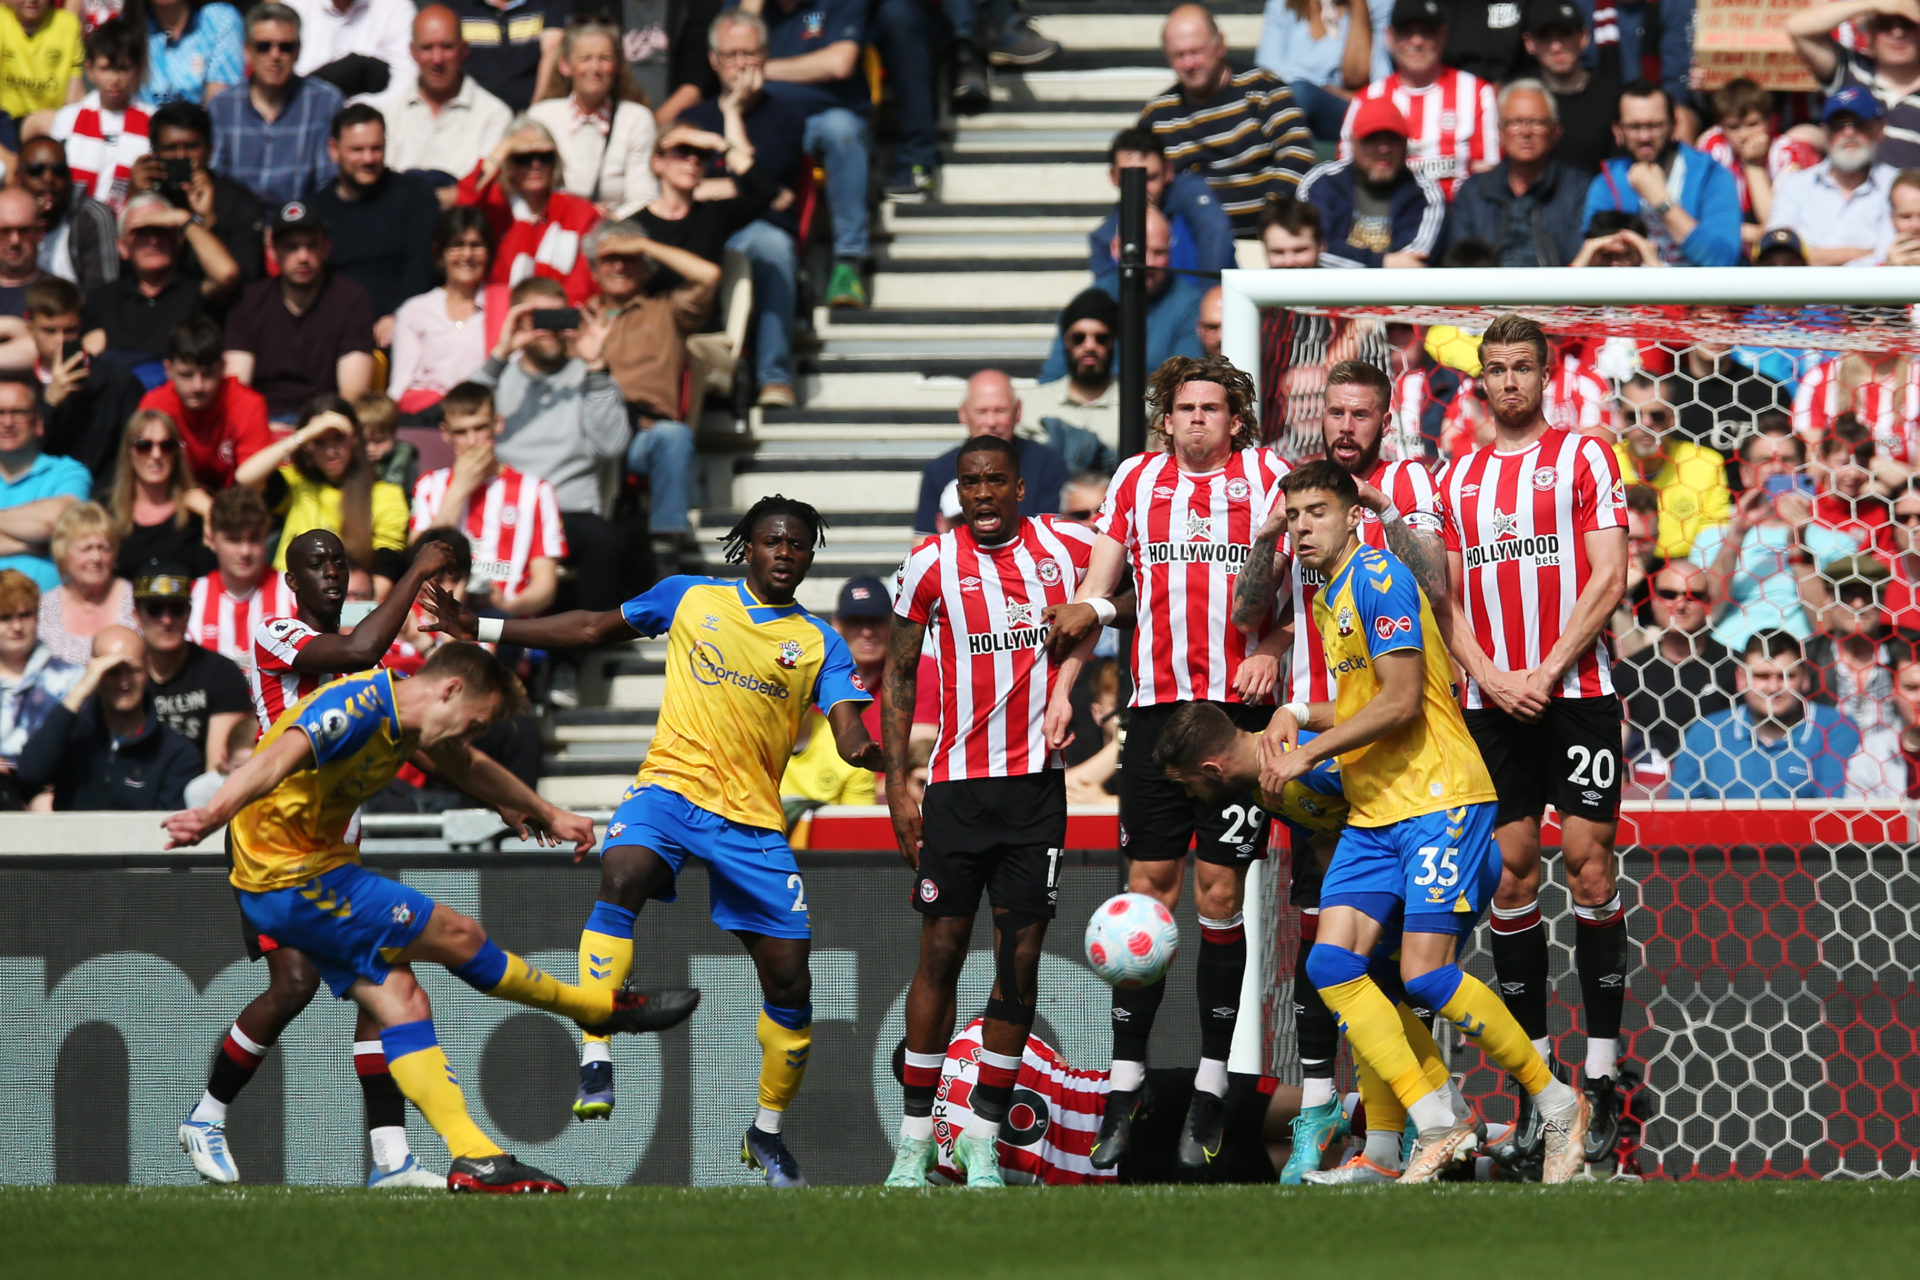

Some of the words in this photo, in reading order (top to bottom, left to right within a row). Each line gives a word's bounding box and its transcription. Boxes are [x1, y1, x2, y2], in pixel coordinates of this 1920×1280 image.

[1149, 541, 1250, 563] HOLLYWOOD
[1225, 563, 1244, 573] bet
[1467, 535, 1559, 568] HOLLYWOOD
[1535, 554, 1559, 567] bets
[968, 626, 1050, 654] HOLLYWO
[1567, 744, 1615, 789] 20
[1218, 804, 1266, 844] 29
[1047, 847, 1064, 888] 1
[1414, 846, 1459, 887] 35
